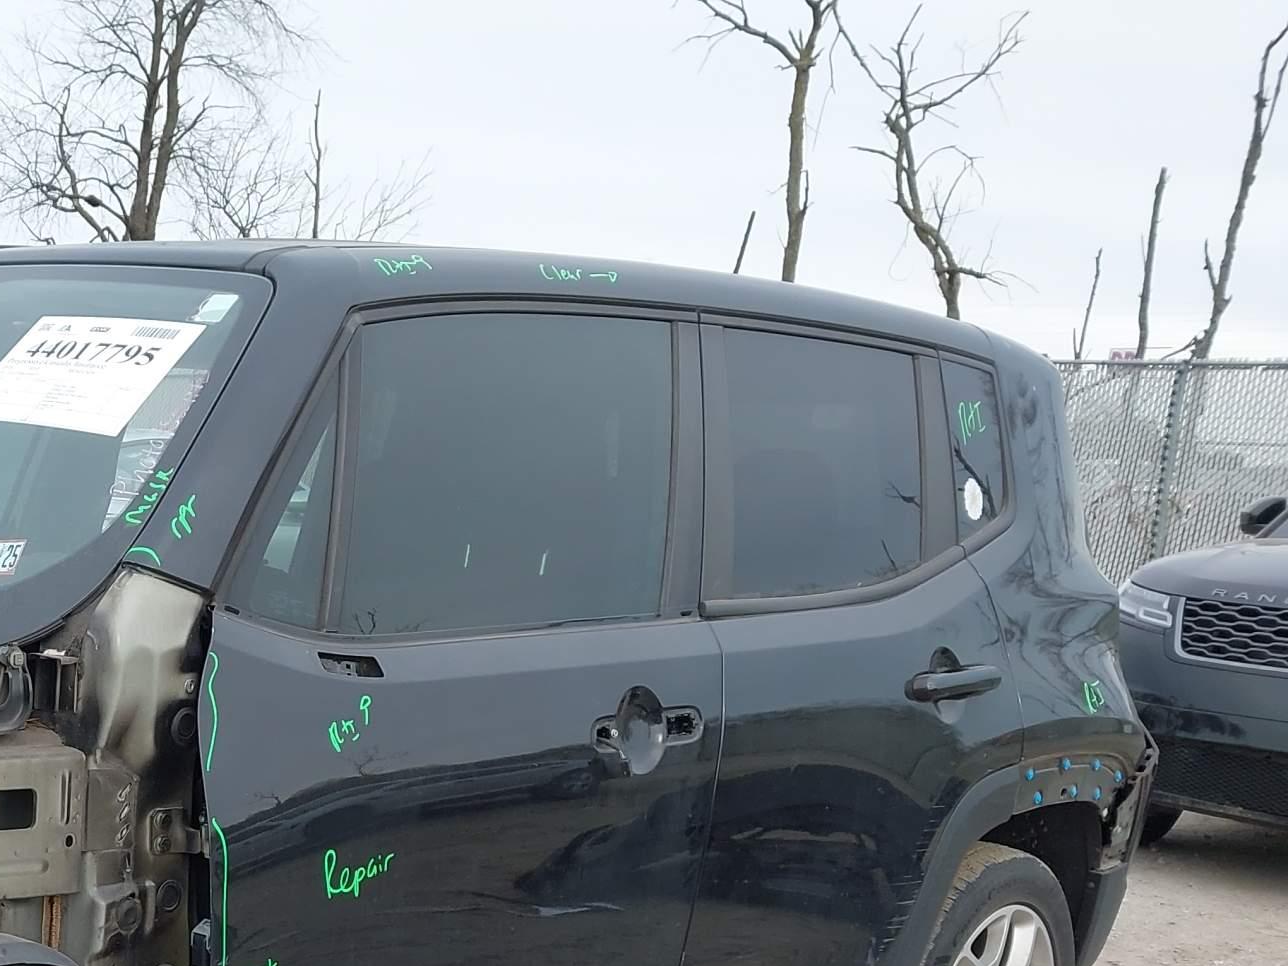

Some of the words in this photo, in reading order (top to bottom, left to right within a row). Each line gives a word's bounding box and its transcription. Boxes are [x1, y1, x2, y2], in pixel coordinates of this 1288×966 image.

[26, 340, 162, 367] 44017795
[1, 544, 22, 568] 25
[324, 849, 395, 899] Repair
